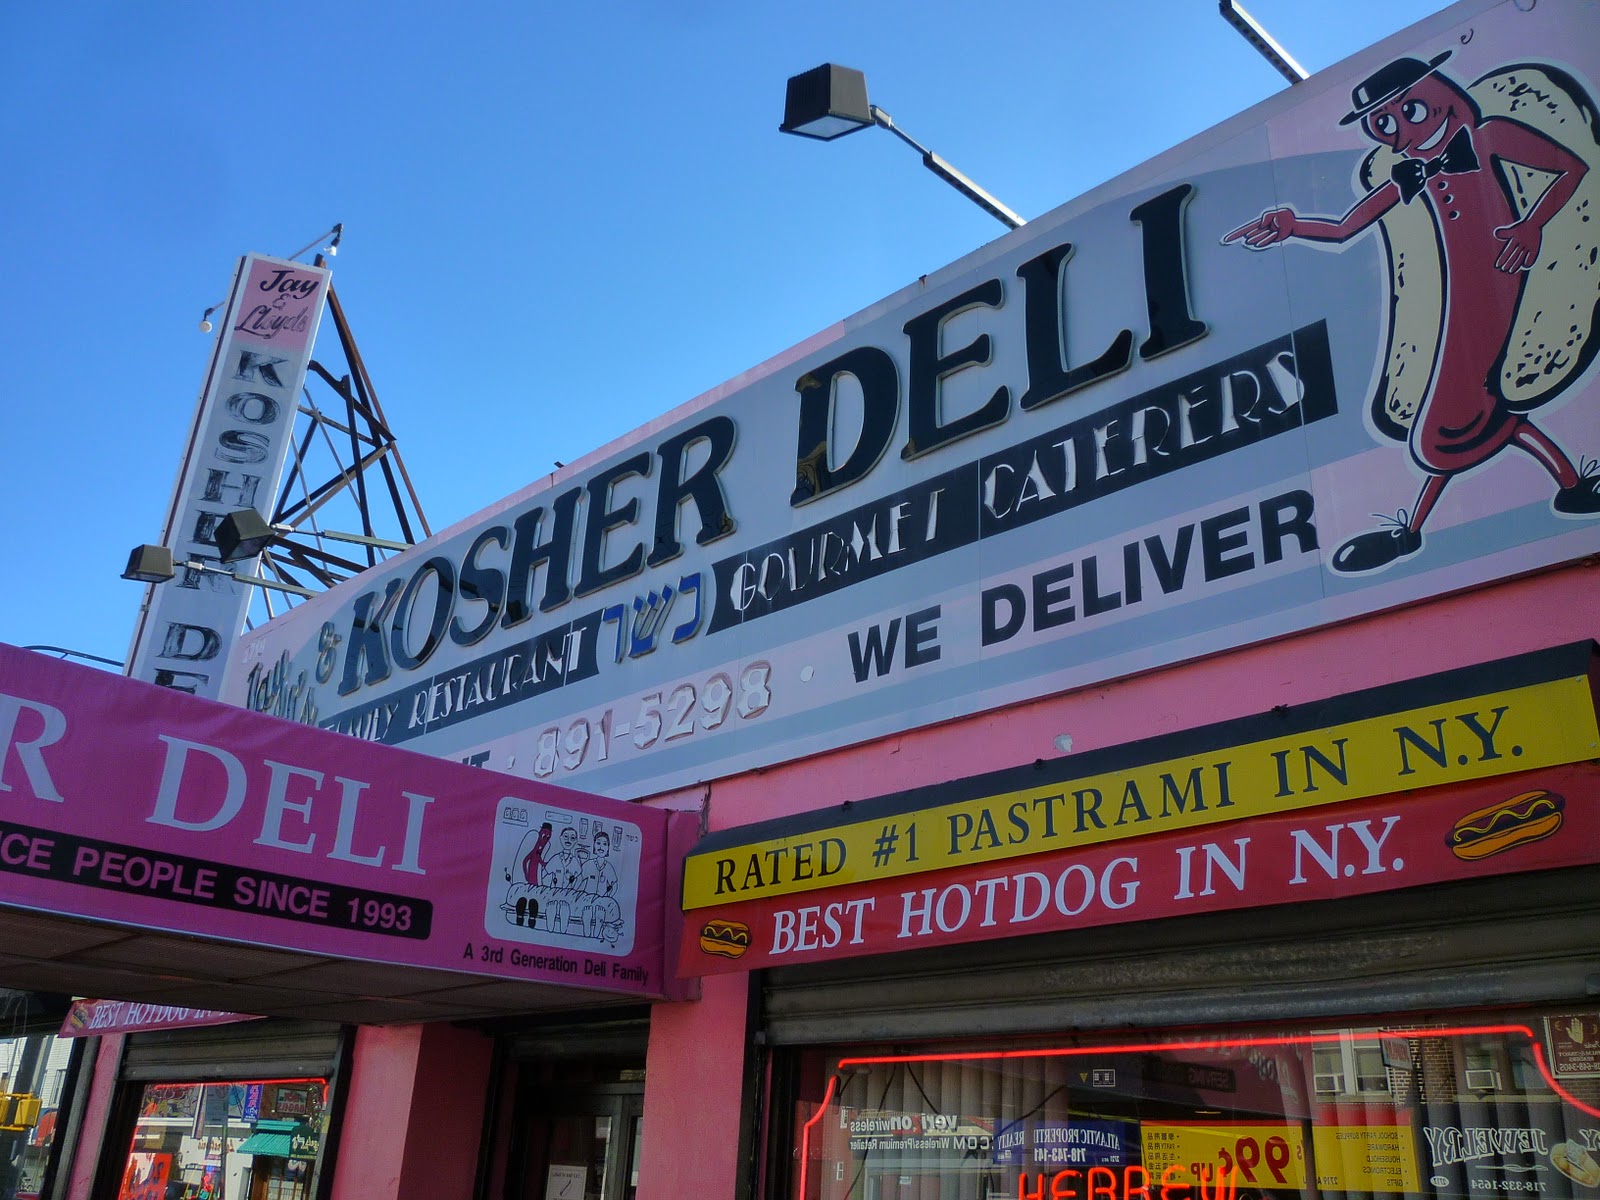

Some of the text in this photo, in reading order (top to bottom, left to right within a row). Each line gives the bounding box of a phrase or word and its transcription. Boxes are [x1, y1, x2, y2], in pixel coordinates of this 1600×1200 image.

[260, 270, 319, 300] Jay
[178, 350, 288, 595] KOSHER
[337, 183, 1210, 697] KOSHER DELI
[729, 350, 1306, 612] GOURMET CATERERS
[407, 627, 587, 729] RESTAURANT
[533, 489, 1319, 779] 891-5298 WE DELIVER
[601, 572, 705, 664] כשר
[145, 734, 435, 876] DELI
[715, 705, 1524, 896] RATED #1 PASTRAMI IN N.Y.
[73, 845, 216, 899] PEOPLE
[235, 875, 330, 920] SINCE
[346, 897, 413, 932] 1993
[768, 814, 1406, 957] BEST HOTDOG IN N.Y.
[88, 1001, 126, 1030] BEST
[463, 943, 649, 986] A 3rd Generation Deli Family
[1017, 1165, 1239, 1200] HEBREW
